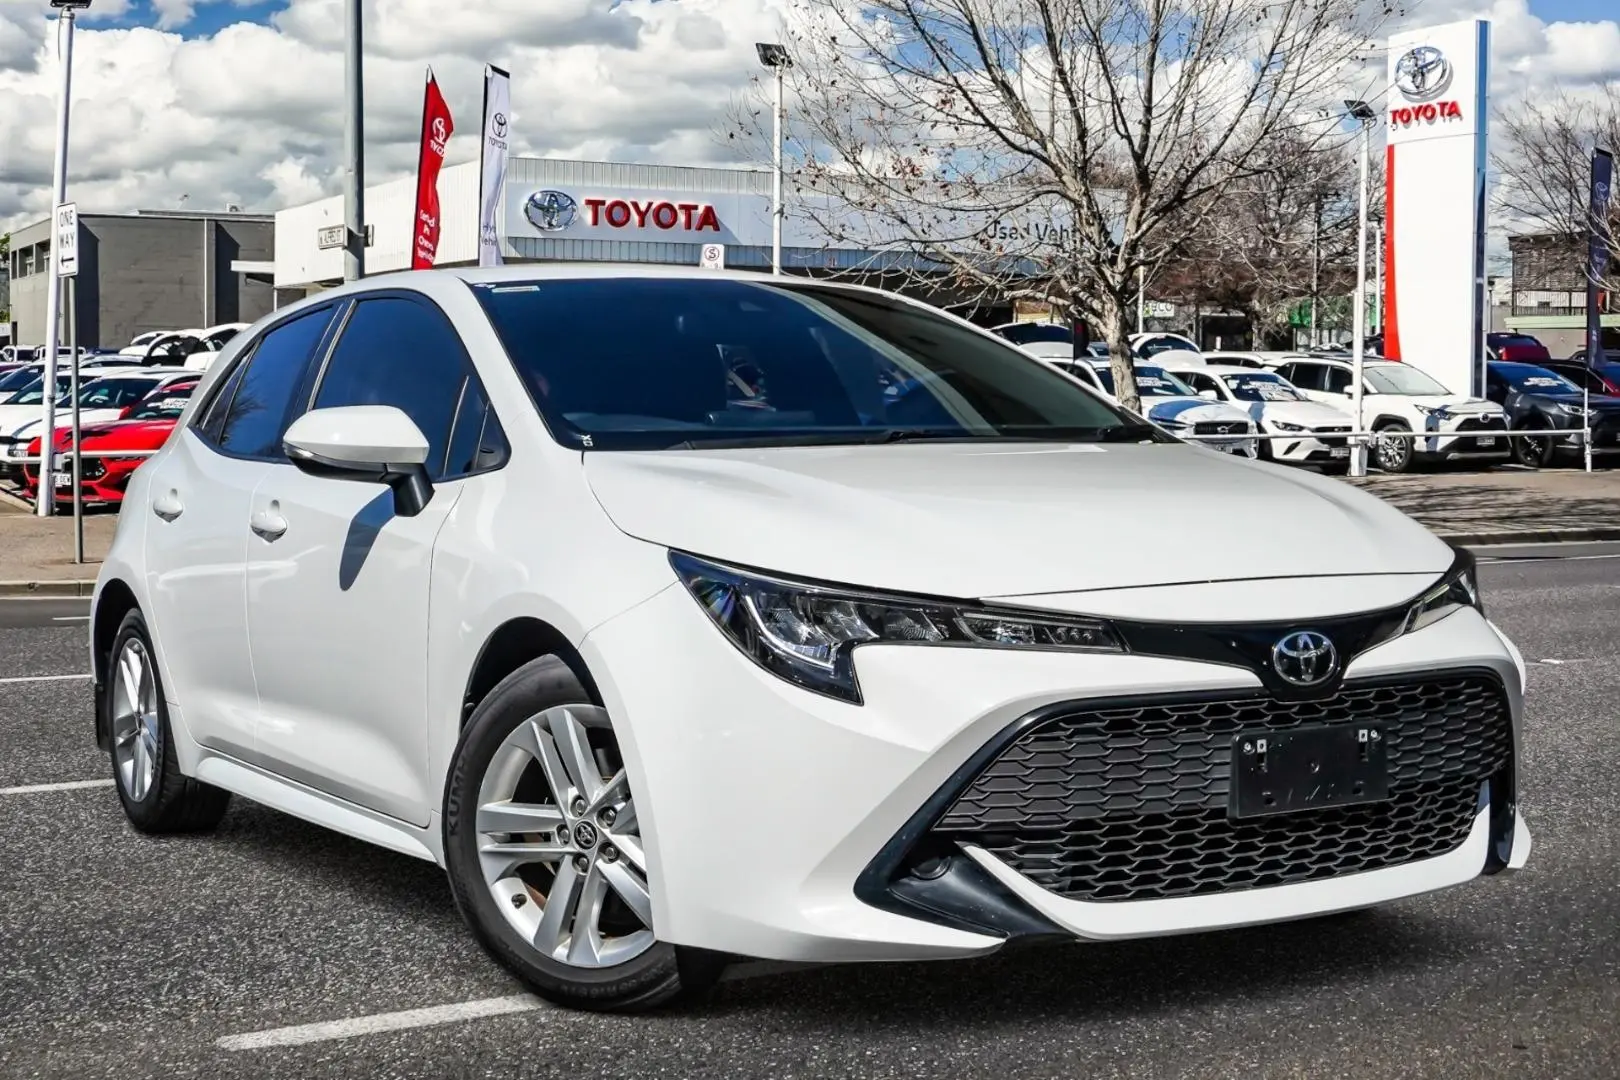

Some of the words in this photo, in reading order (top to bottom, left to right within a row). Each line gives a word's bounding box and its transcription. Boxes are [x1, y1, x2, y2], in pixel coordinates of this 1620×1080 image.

[1389, 101, 1462, 125] TOYOTA
[60, 209, 73, 227] ONE
[584, 198, 720, 232] TOYOTA
[60, 232, 75, 249] WAY
